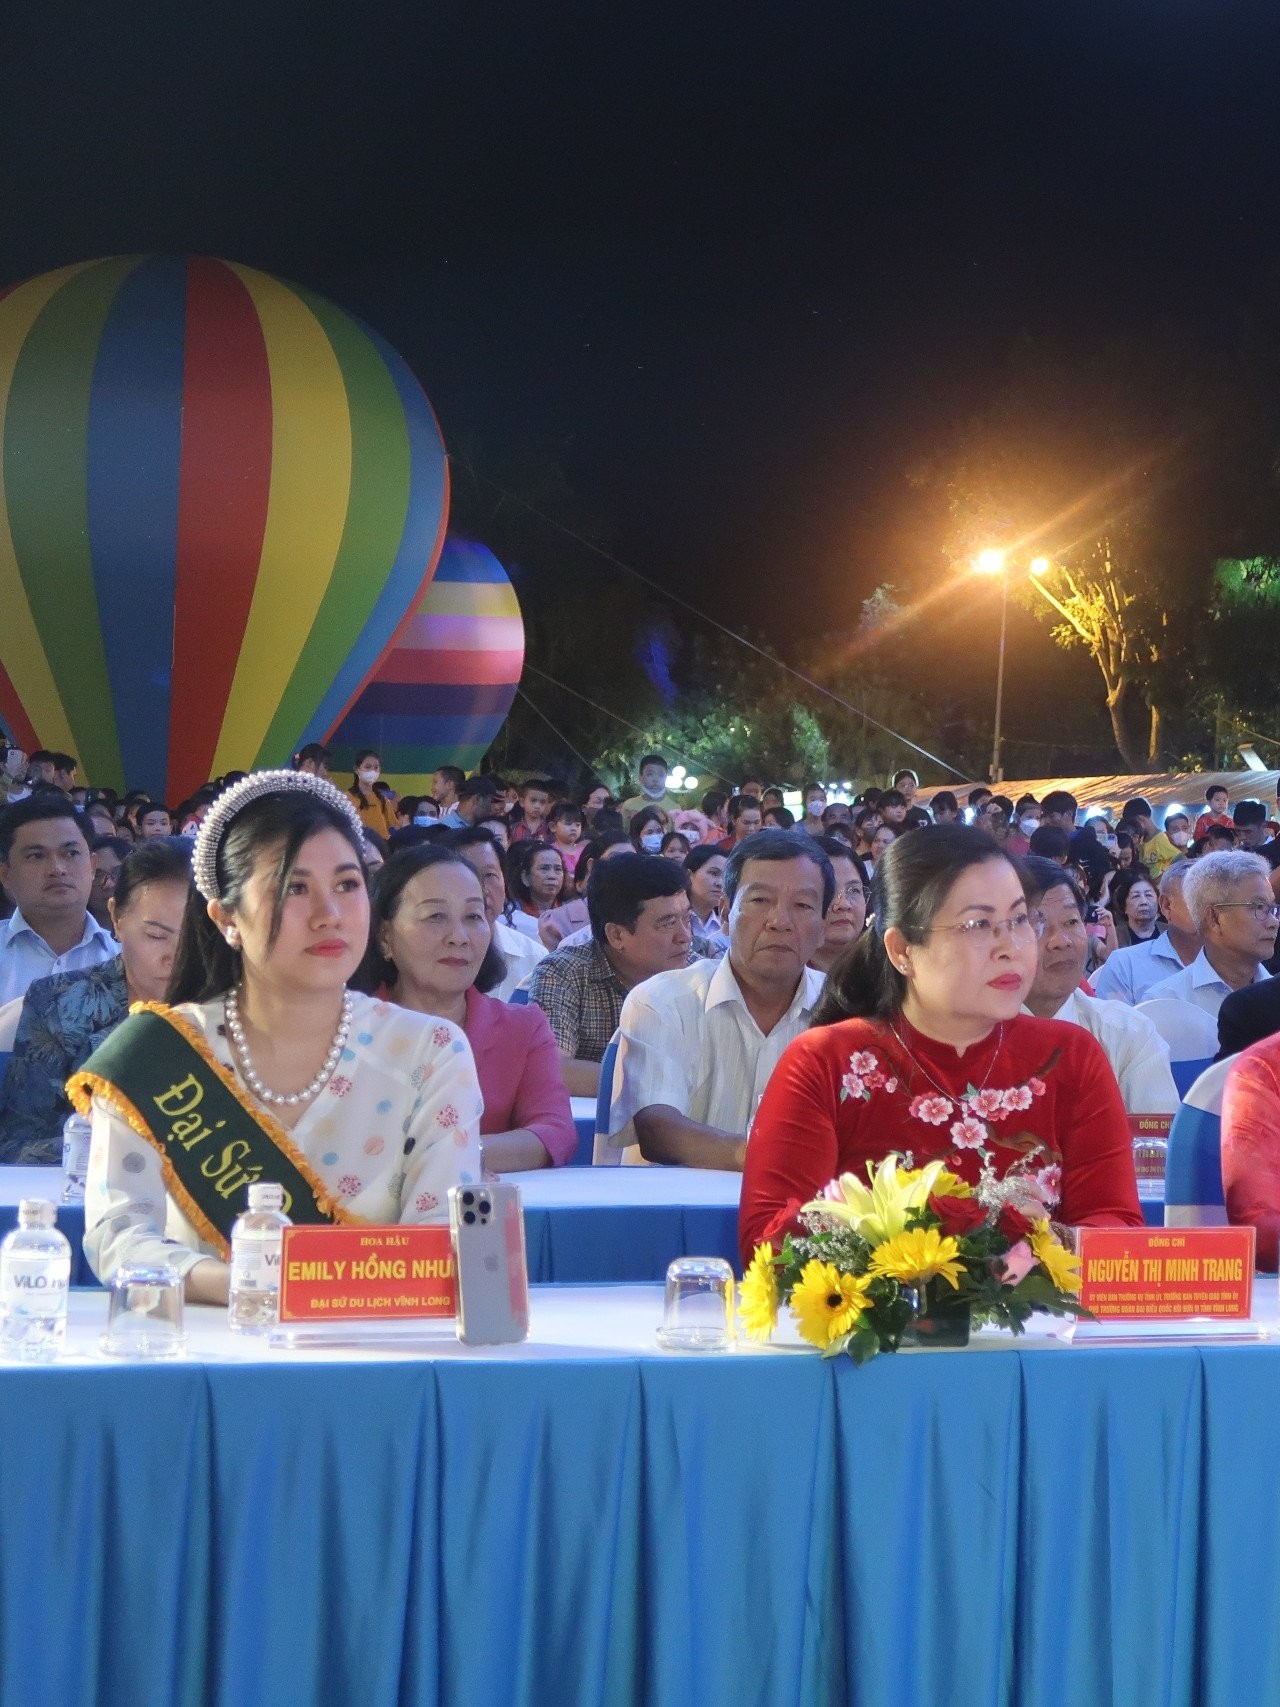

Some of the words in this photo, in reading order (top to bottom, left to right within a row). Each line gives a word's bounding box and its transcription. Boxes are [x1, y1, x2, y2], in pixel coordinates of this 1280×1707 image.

[153, 1073, 226, 1151] Đại
[201, 1140, 263, 1199] Sứ
[360, 1237, 383, 1246] HOA
[386, 1236, 410, 1247] HẬU
[287, 1261, 346, 1281] EMILY
[351, 1252, 407, 1280] HỒNG
[411, 1259, 454, 1279] NHU
[1087, 1250, 1139, 1283] NGUYỄN
[1142, 1259, 1162, 1288] THỊ
[1165, 1258, 1199, 1282] MINH
[1202, 1258, 1243, 1282] TRANG
[349, 1298, 364, 1308] DU
[367, 1297, 391, 1309] LỊCH
[394, 1295, 419, 1307] VĨNH
[421, 1296, 451, 1306] LONG
